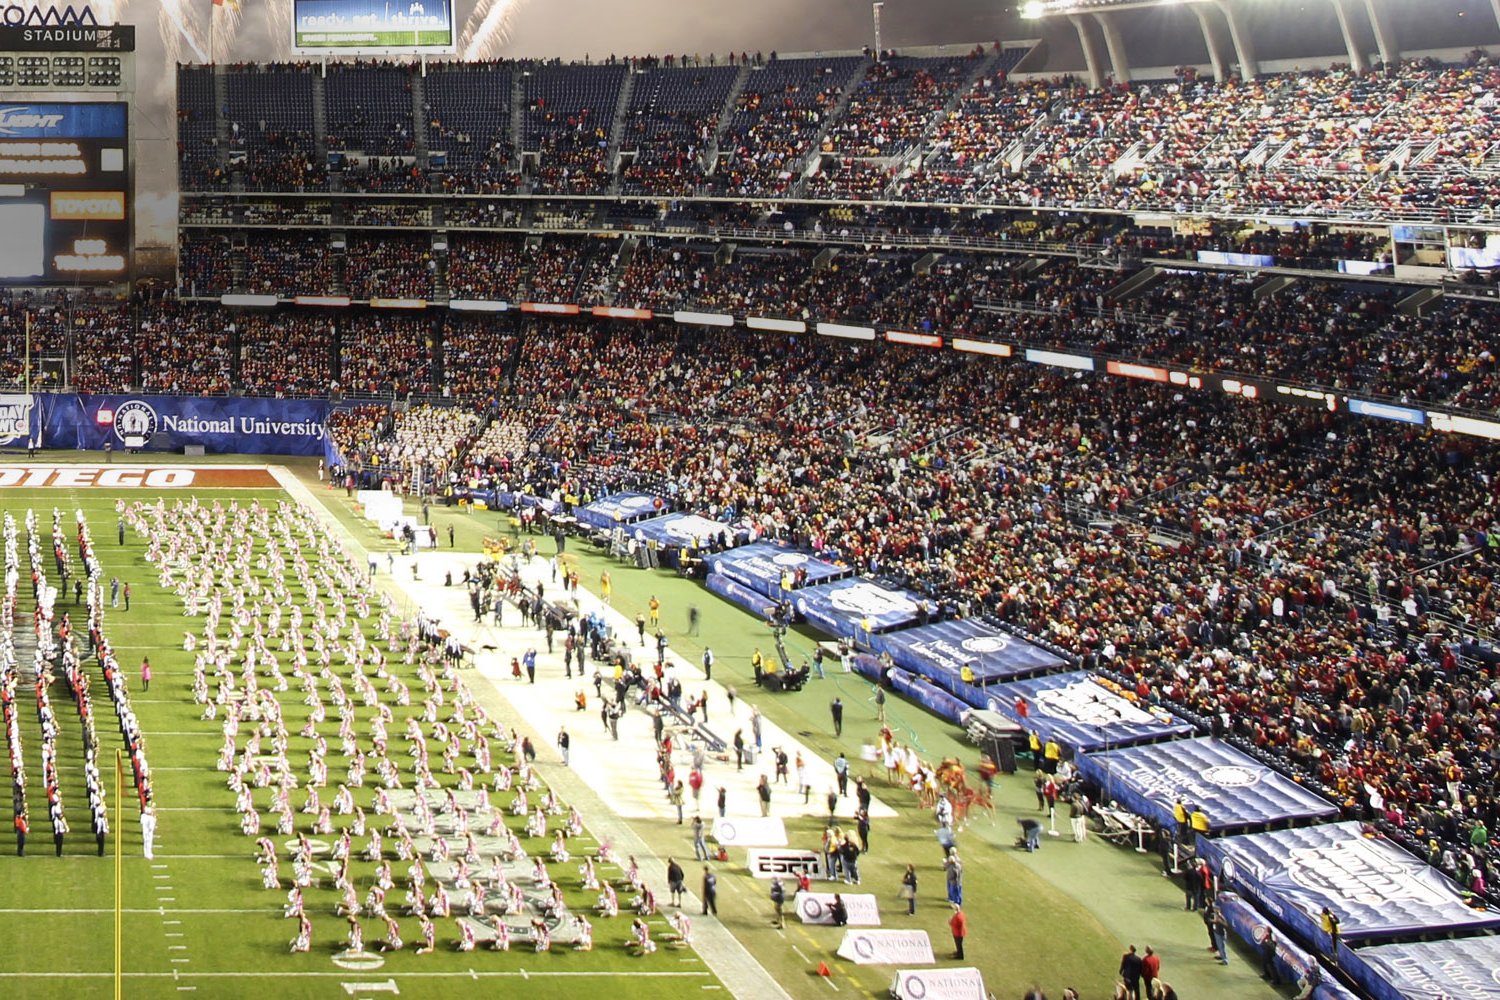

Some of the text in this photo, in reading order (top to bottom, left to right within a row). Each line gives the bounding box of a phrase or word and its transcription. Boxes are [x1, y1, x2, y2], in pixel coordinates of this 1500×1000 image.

[391, 11, 443, 25] thrive.
[23, 29, 96, 41] STADIUM
[54, 199, 122, 214] TOYOTA
[162, 414, 326, 440] National University
[758, 856, 819, 874] ESPN
[1434, 959, 1492, 1000] Nation
